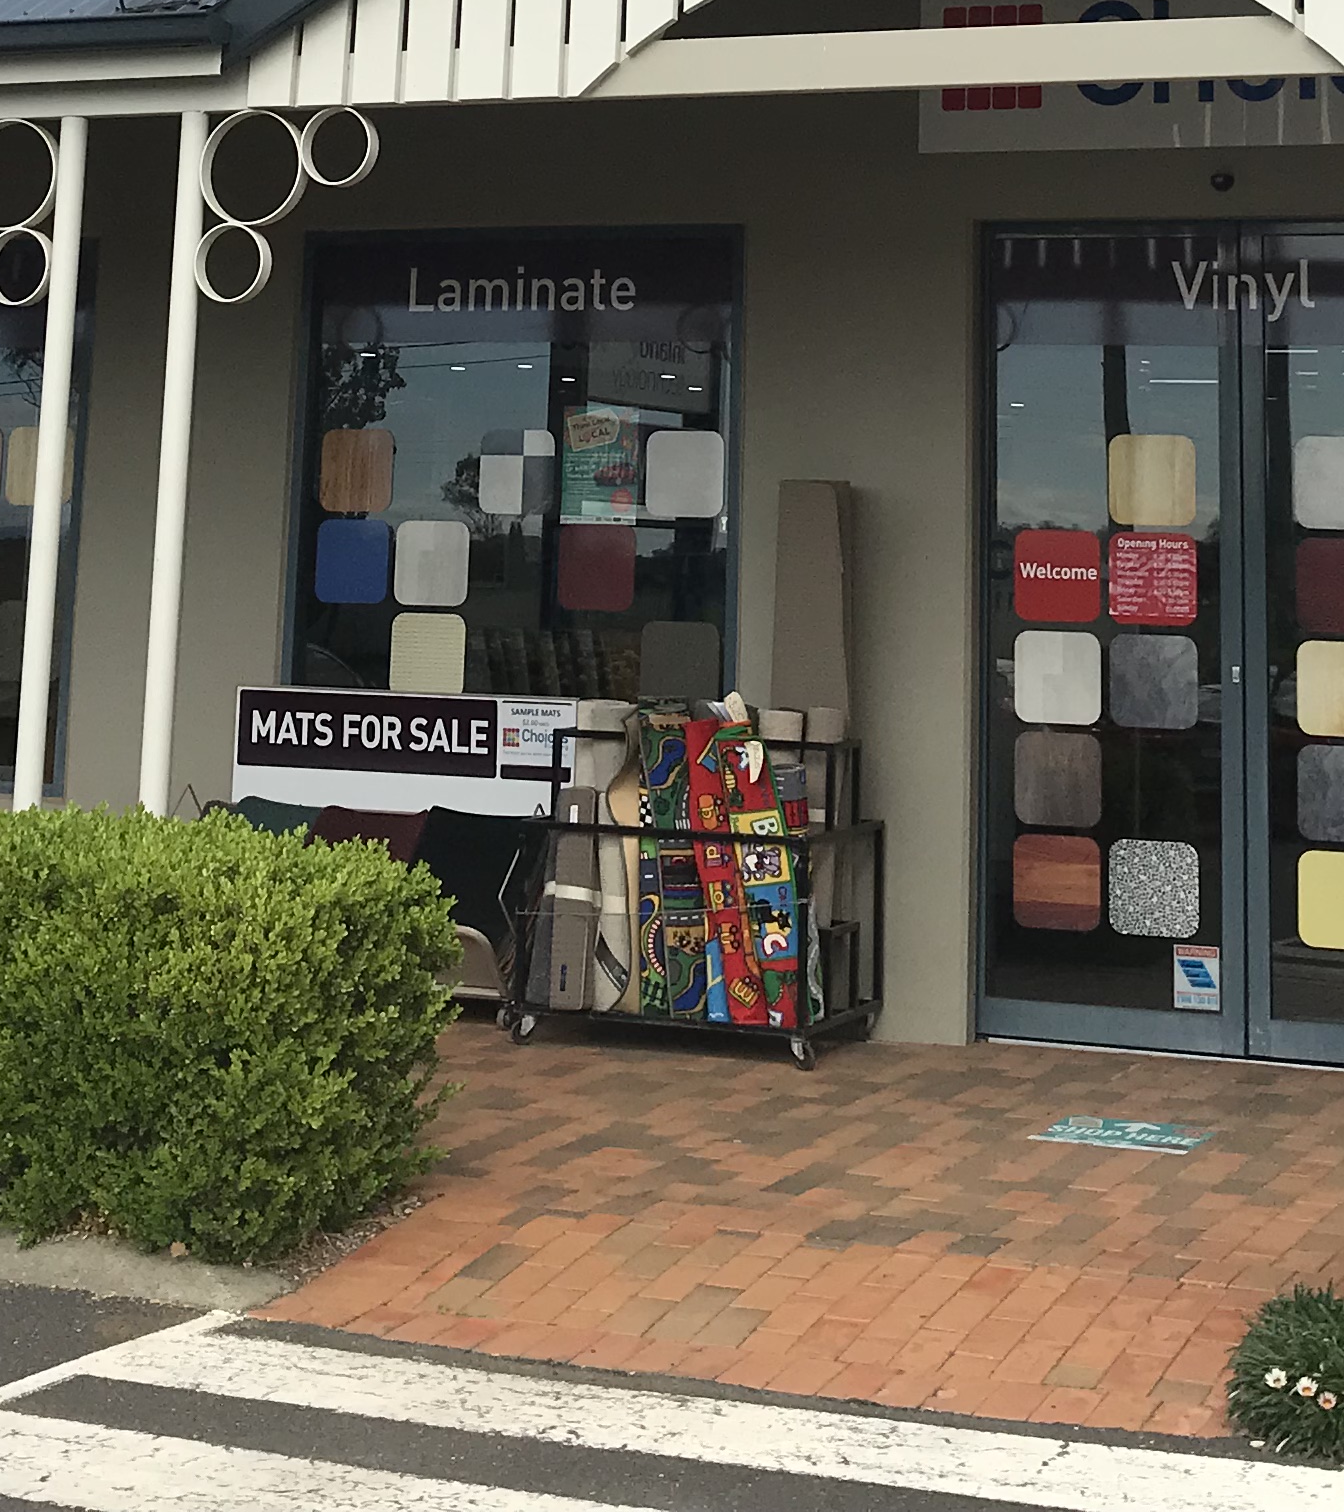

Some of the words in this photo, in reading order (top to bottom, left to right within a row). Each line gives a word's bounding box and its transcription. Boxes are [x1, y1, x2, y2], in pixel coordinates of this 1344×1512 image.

[409, 266, 637, 312] Laminate
[1171, 259, 1316, 322] Vinyl
[1117, 537, 1157, 550] Opening
[1159, 539, 1189, 549] Hours
[1019, 562, 1098, 580] Welcome
[511, 708, 539, 717] SAMPLE
[541, 709, 561, 718] MATS
[251, 709, 333, 747] MATS
[342, 713, 402, 750] FOR
[409, 717, 489, 755] SALE
[1047, 1124, 1122, 1138] SHOP
[1124, 1132, 1201, 1146] HERE
